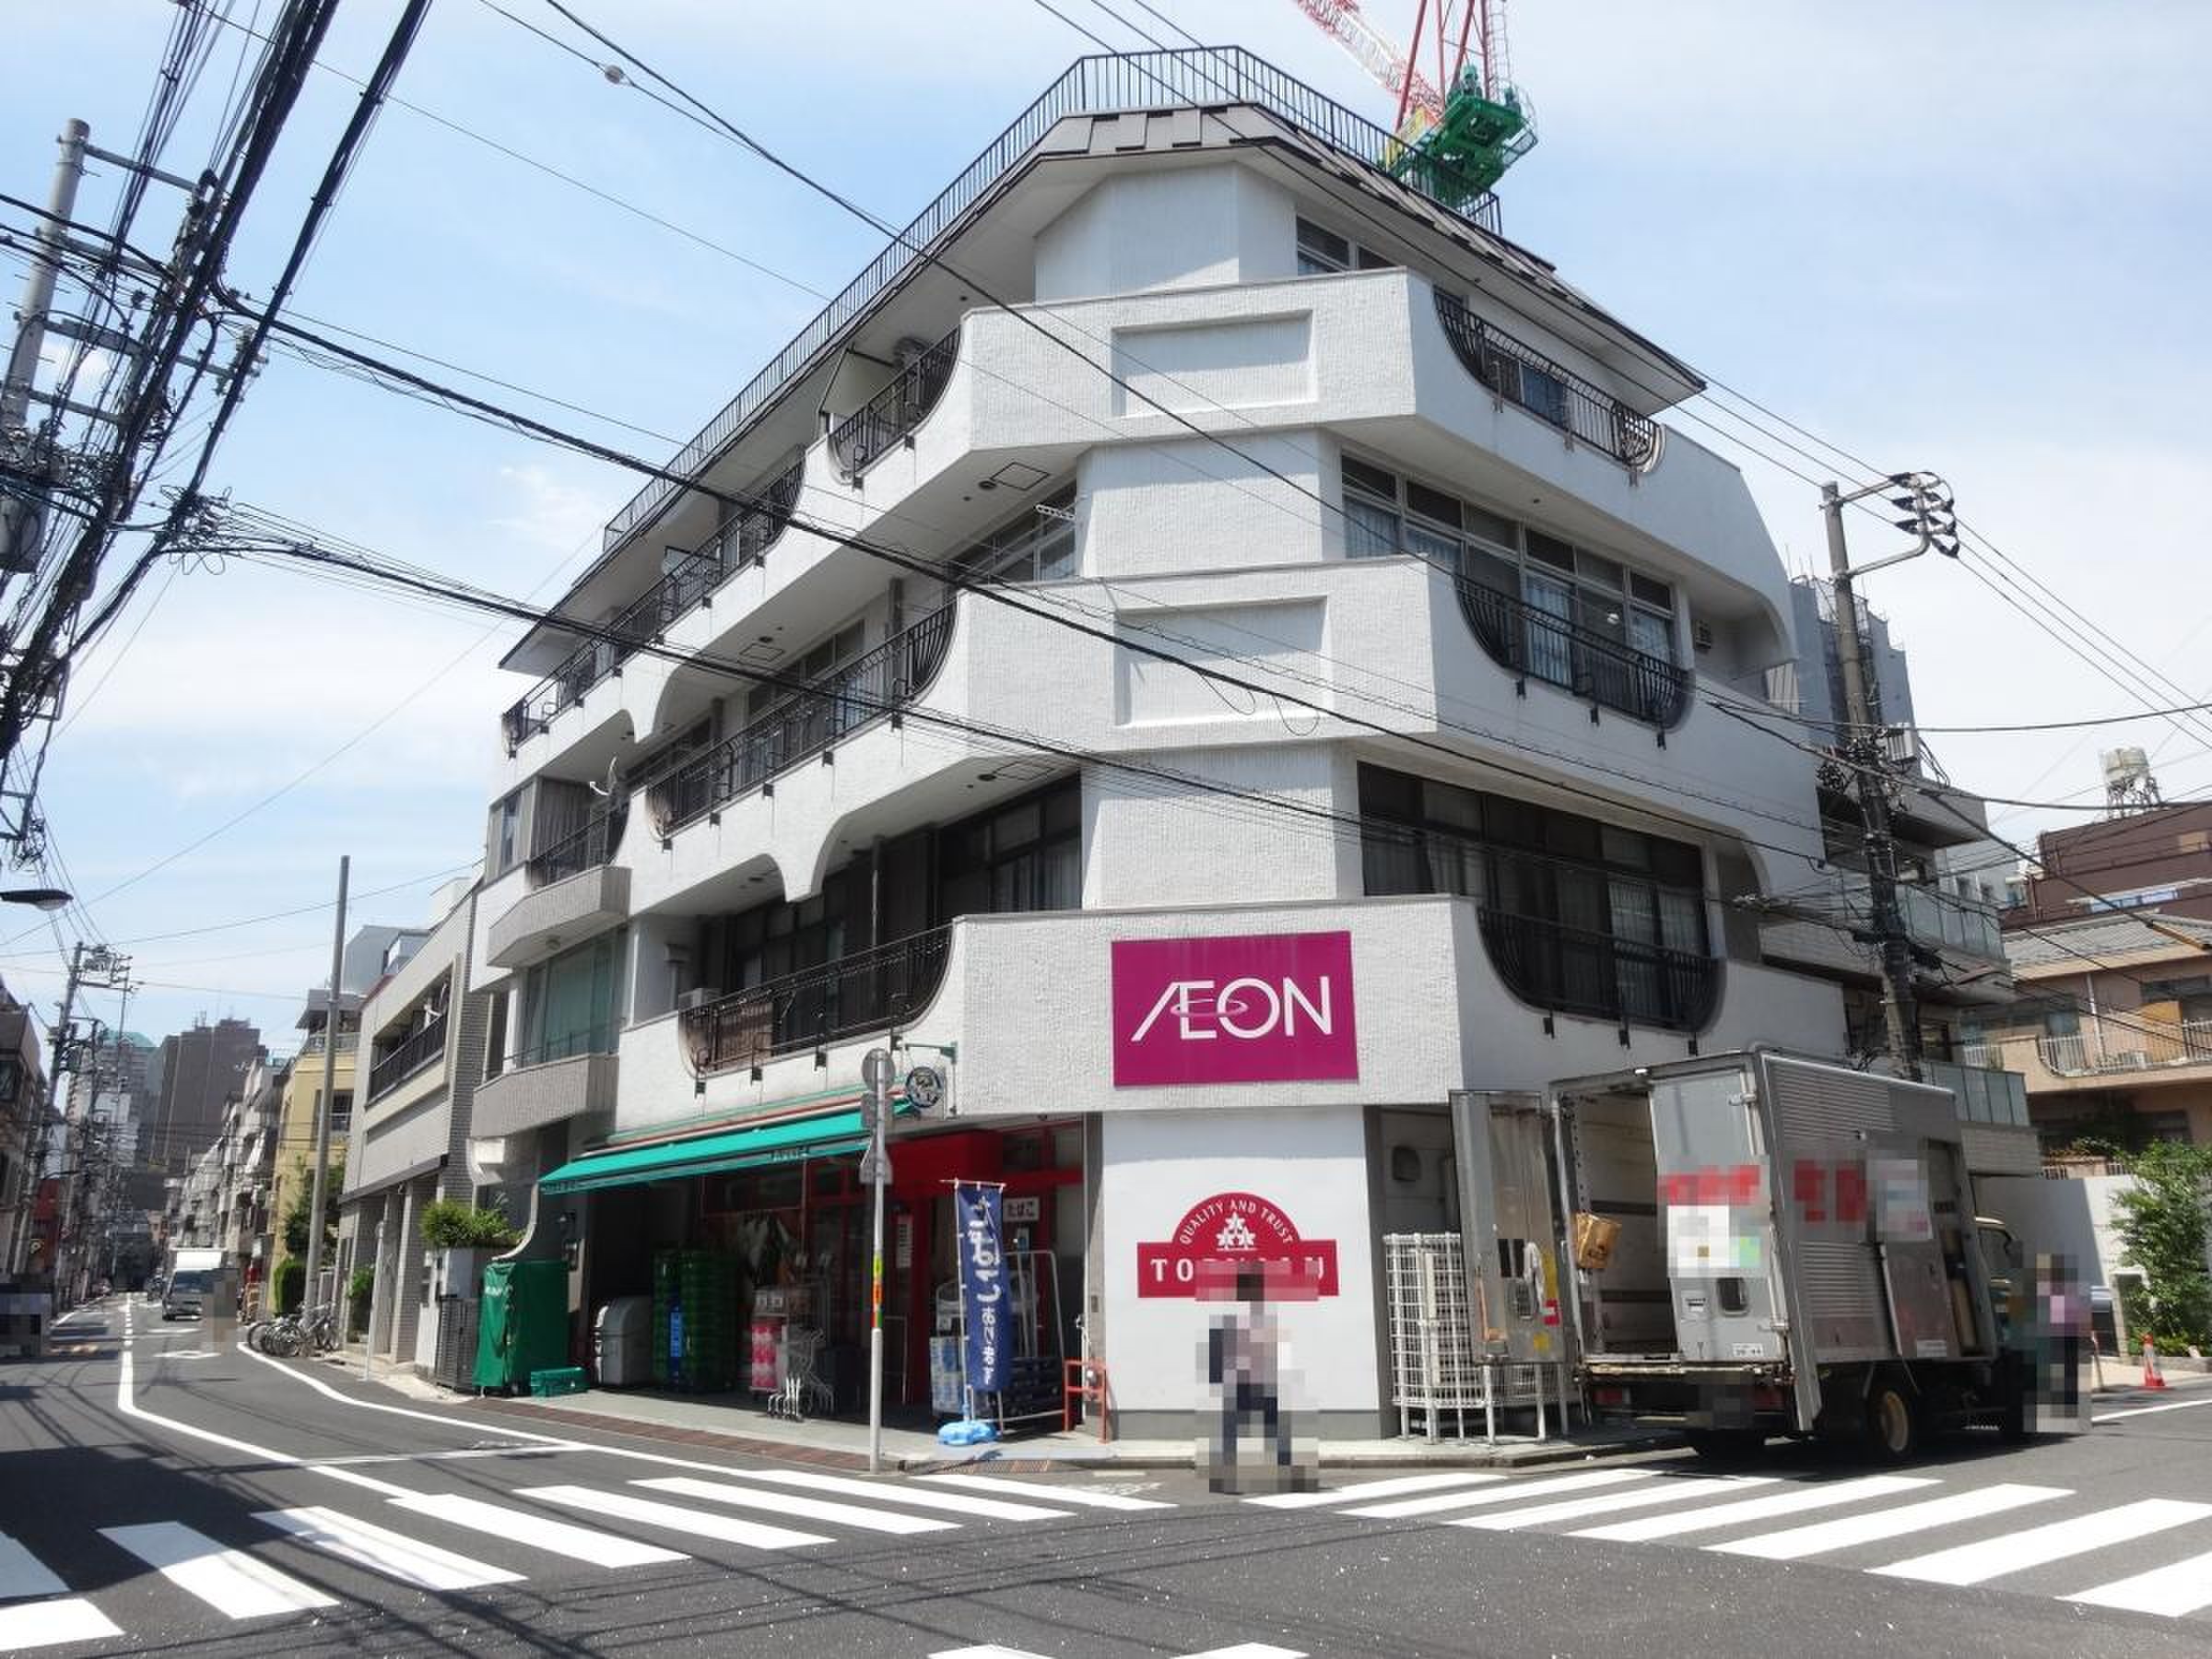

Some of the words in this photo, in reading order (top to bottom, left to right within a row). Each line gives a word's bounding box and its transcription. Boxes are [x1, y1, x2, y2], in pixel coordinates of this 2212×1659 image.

[1179, 1201, 1224, 1244] QUALITY
[1230, 1199, 1256, 1214] AND
[1261, 1207, 1294, 1243] TRUST
